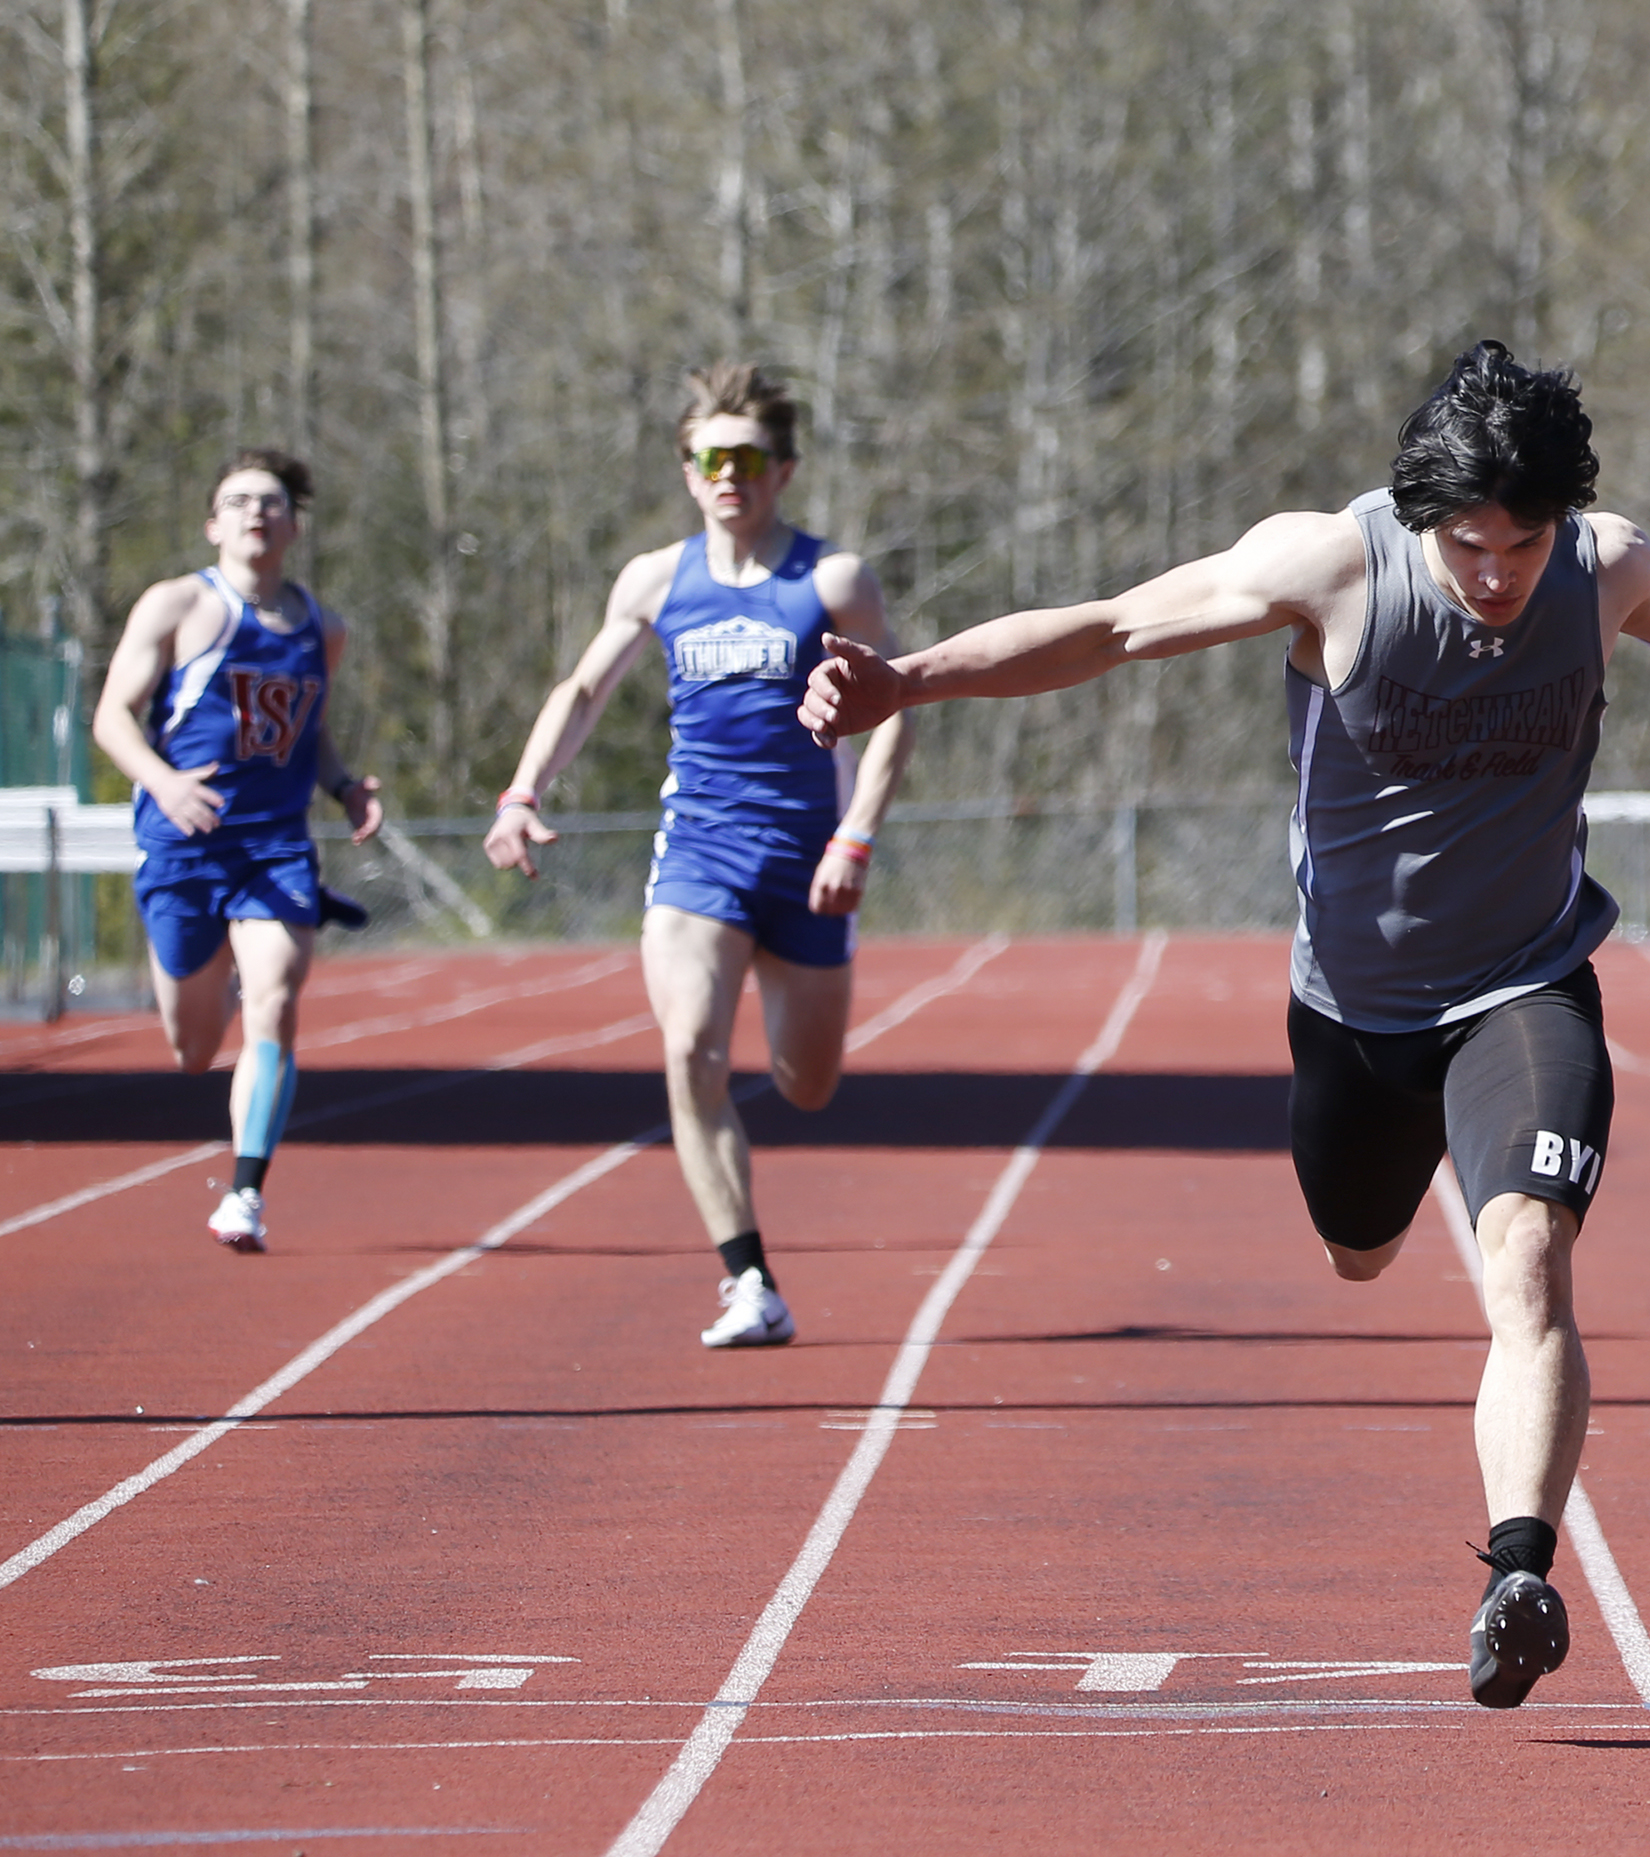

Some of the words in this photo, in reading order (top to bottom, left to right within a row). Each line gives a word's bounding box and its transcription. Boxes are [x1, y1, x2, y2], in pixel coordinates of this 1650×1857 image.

[1368, 667, 1585, 752] KETCHIKAN
[1390, 753, 1457, 781] Track
[1459, 751, 1480, 780] &
[1480, 748, 1545, 778] Field
